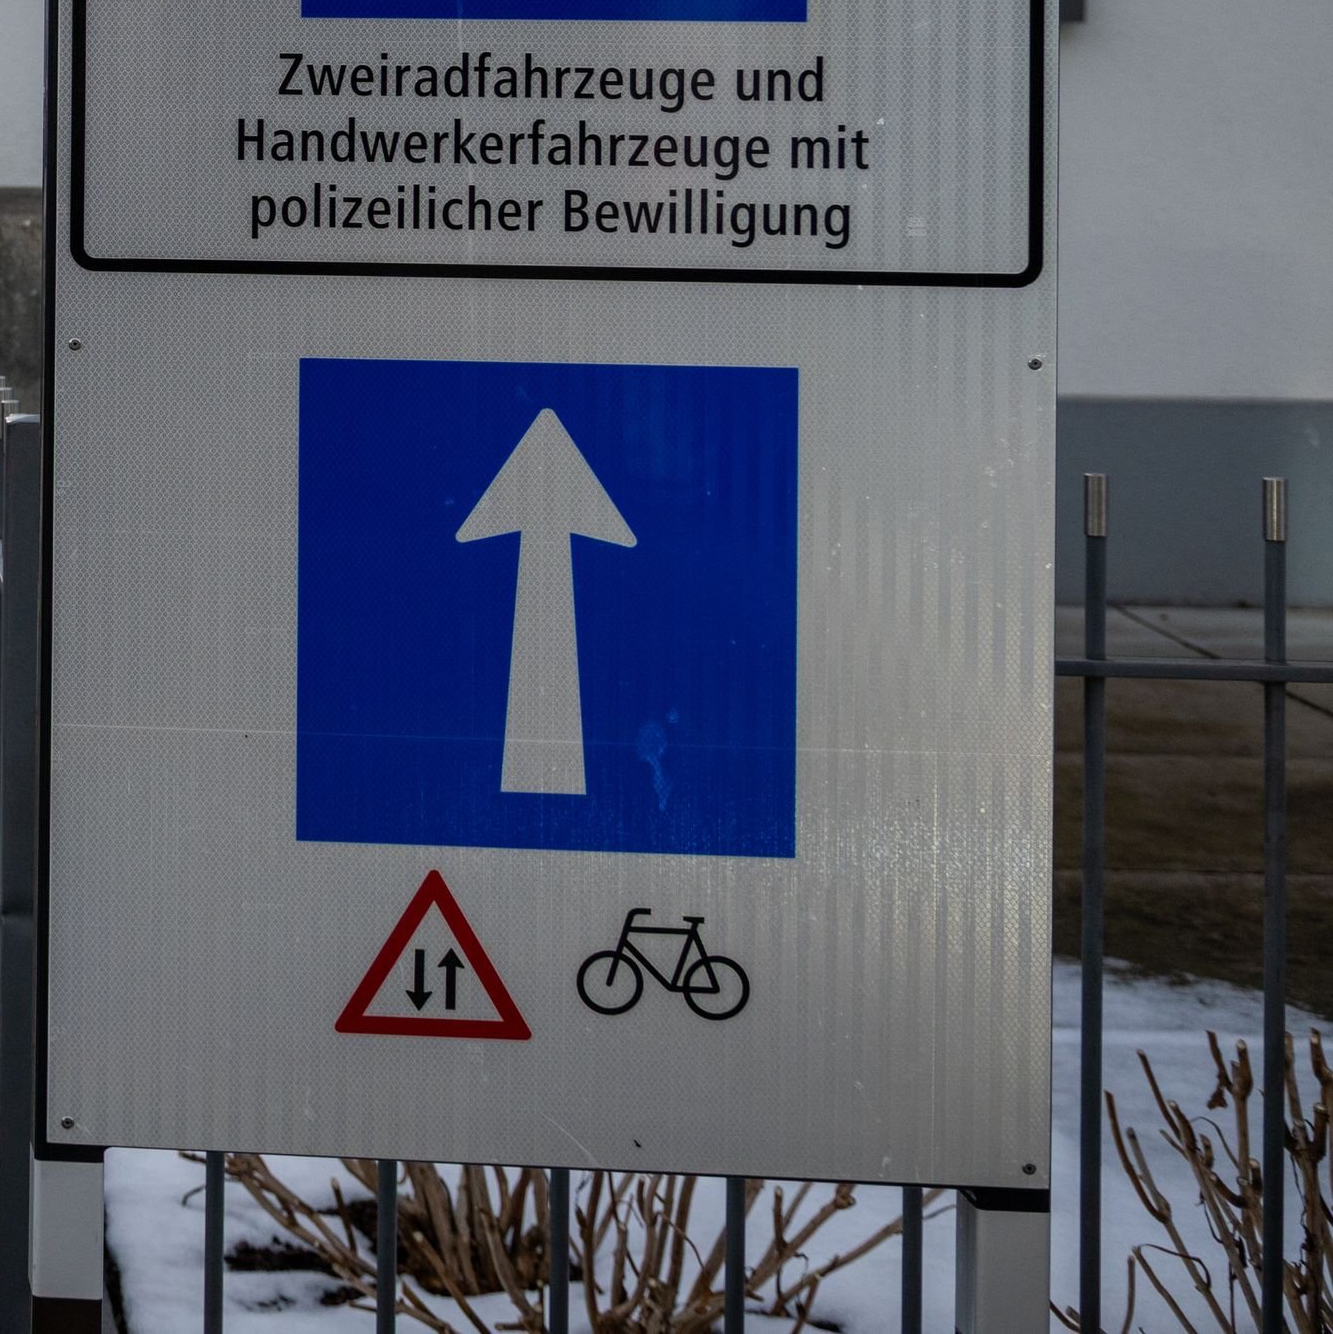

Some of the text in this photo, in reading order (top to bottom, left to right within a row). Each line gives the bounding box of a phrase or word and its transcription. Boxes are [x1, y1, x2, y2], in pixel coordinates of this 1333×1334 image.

[277, 52, 825, 114] Zweiradfahrzeuge und
[236, 117, 870, 181] Handwerkerfahrzeuge mit
[250, 183, 851, 250] polizeilicher Bewilligung
